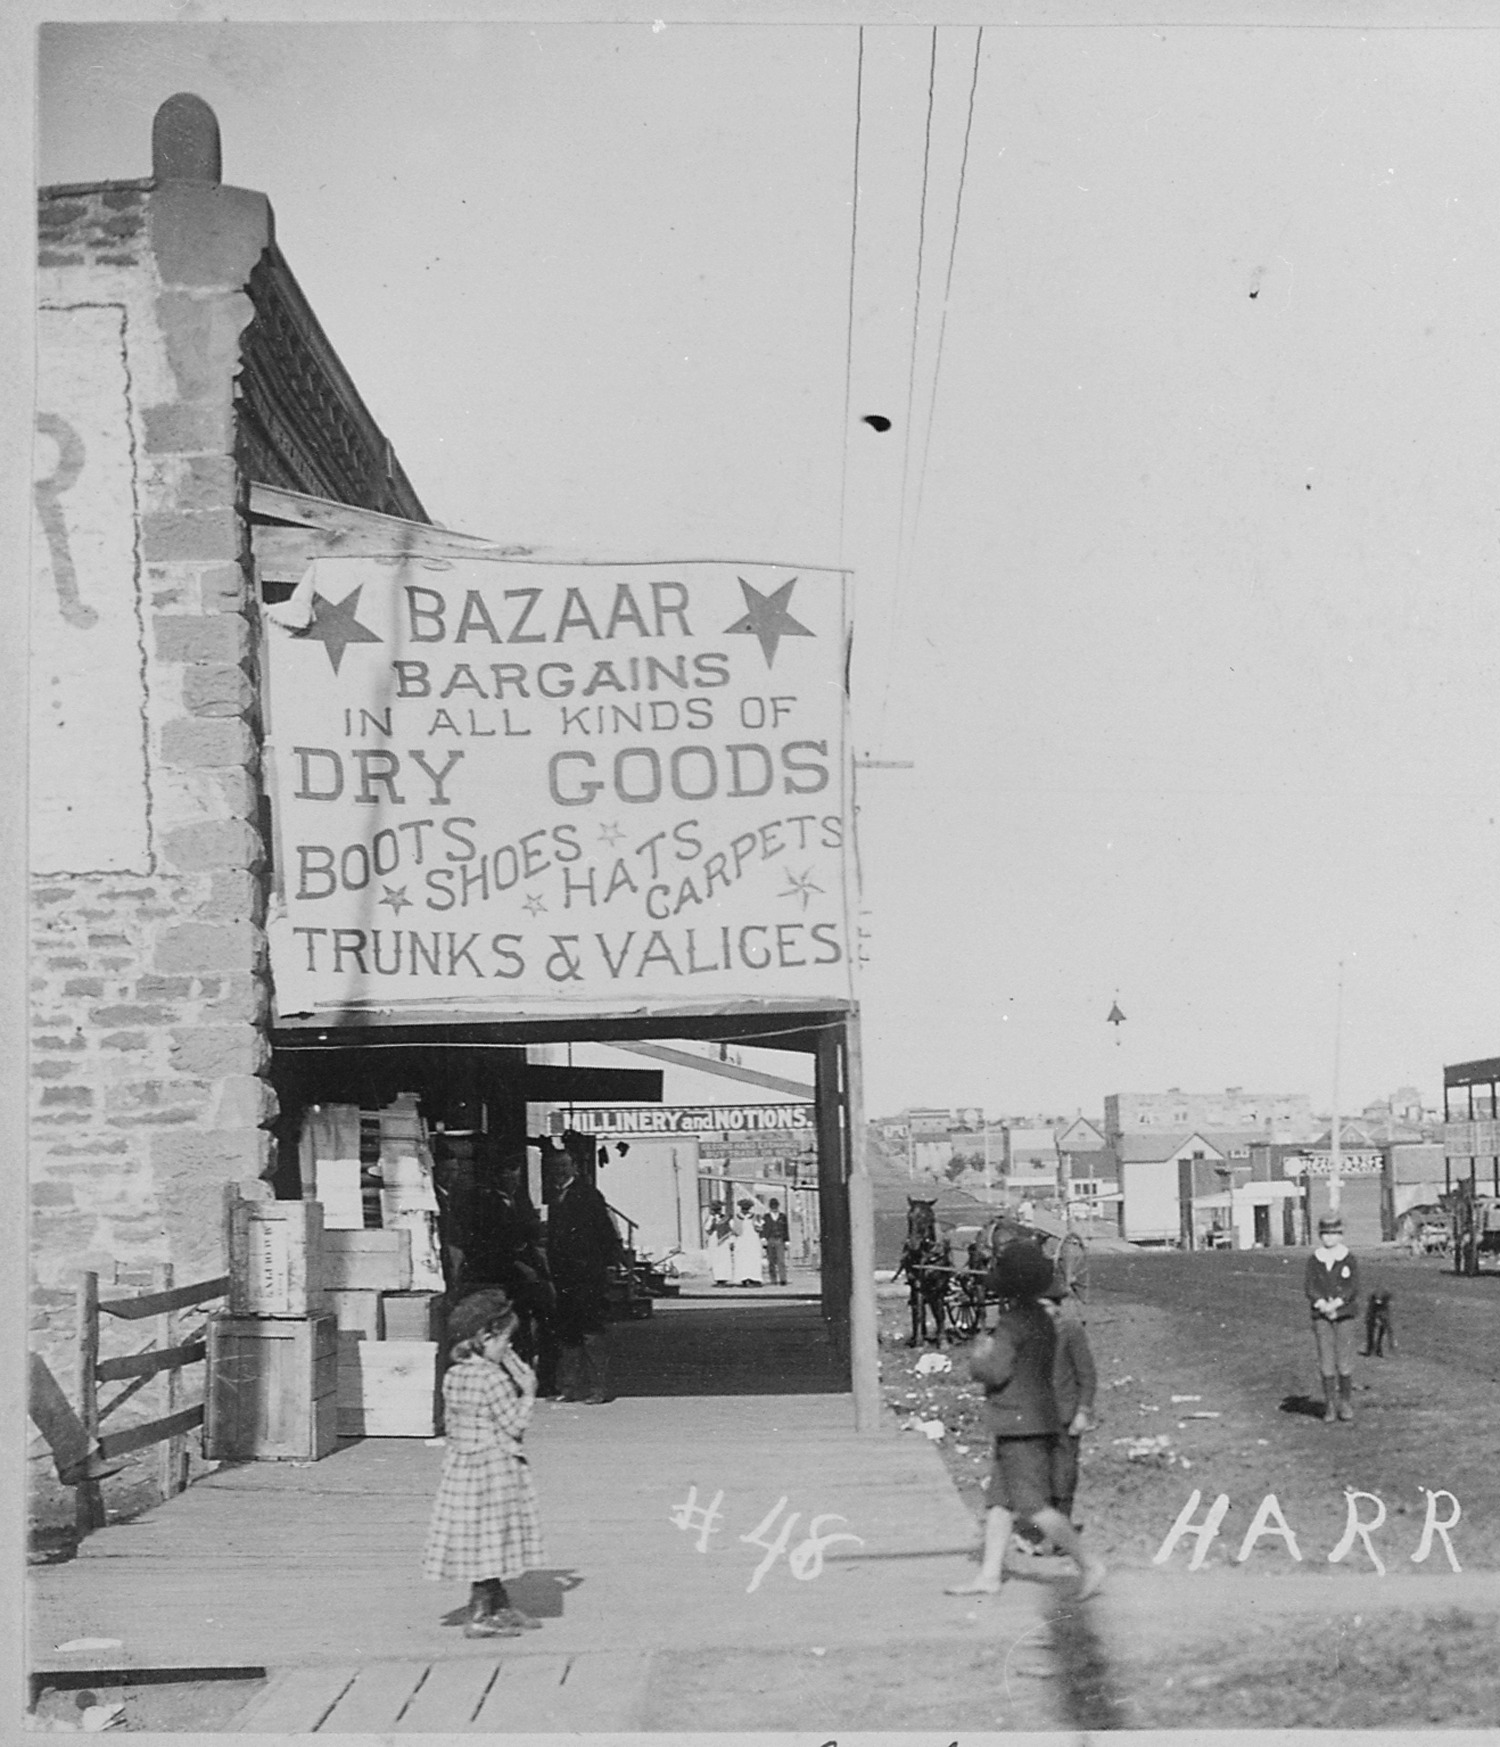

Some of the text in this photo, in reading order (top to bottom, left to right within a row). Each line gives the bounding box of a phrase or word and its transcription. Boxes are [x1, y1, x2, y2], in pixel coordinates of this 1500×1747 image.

[405, 582, 693, 646] BAZAAR
[393, 653, 732, 699] BARGAINS
[344, 696, 798, 737] IN ALL KINDS OF
[293, 740, 831, 806] DRY GOODS
[295, 814, 844, 921] BOOTS SHOES HATS CARPETS
[292, 928, 526, 981] TRUNKS
[546, 934, 583, 982] &
[563, 1107, 813, 1132] MILLINERY and NOTIONS.
